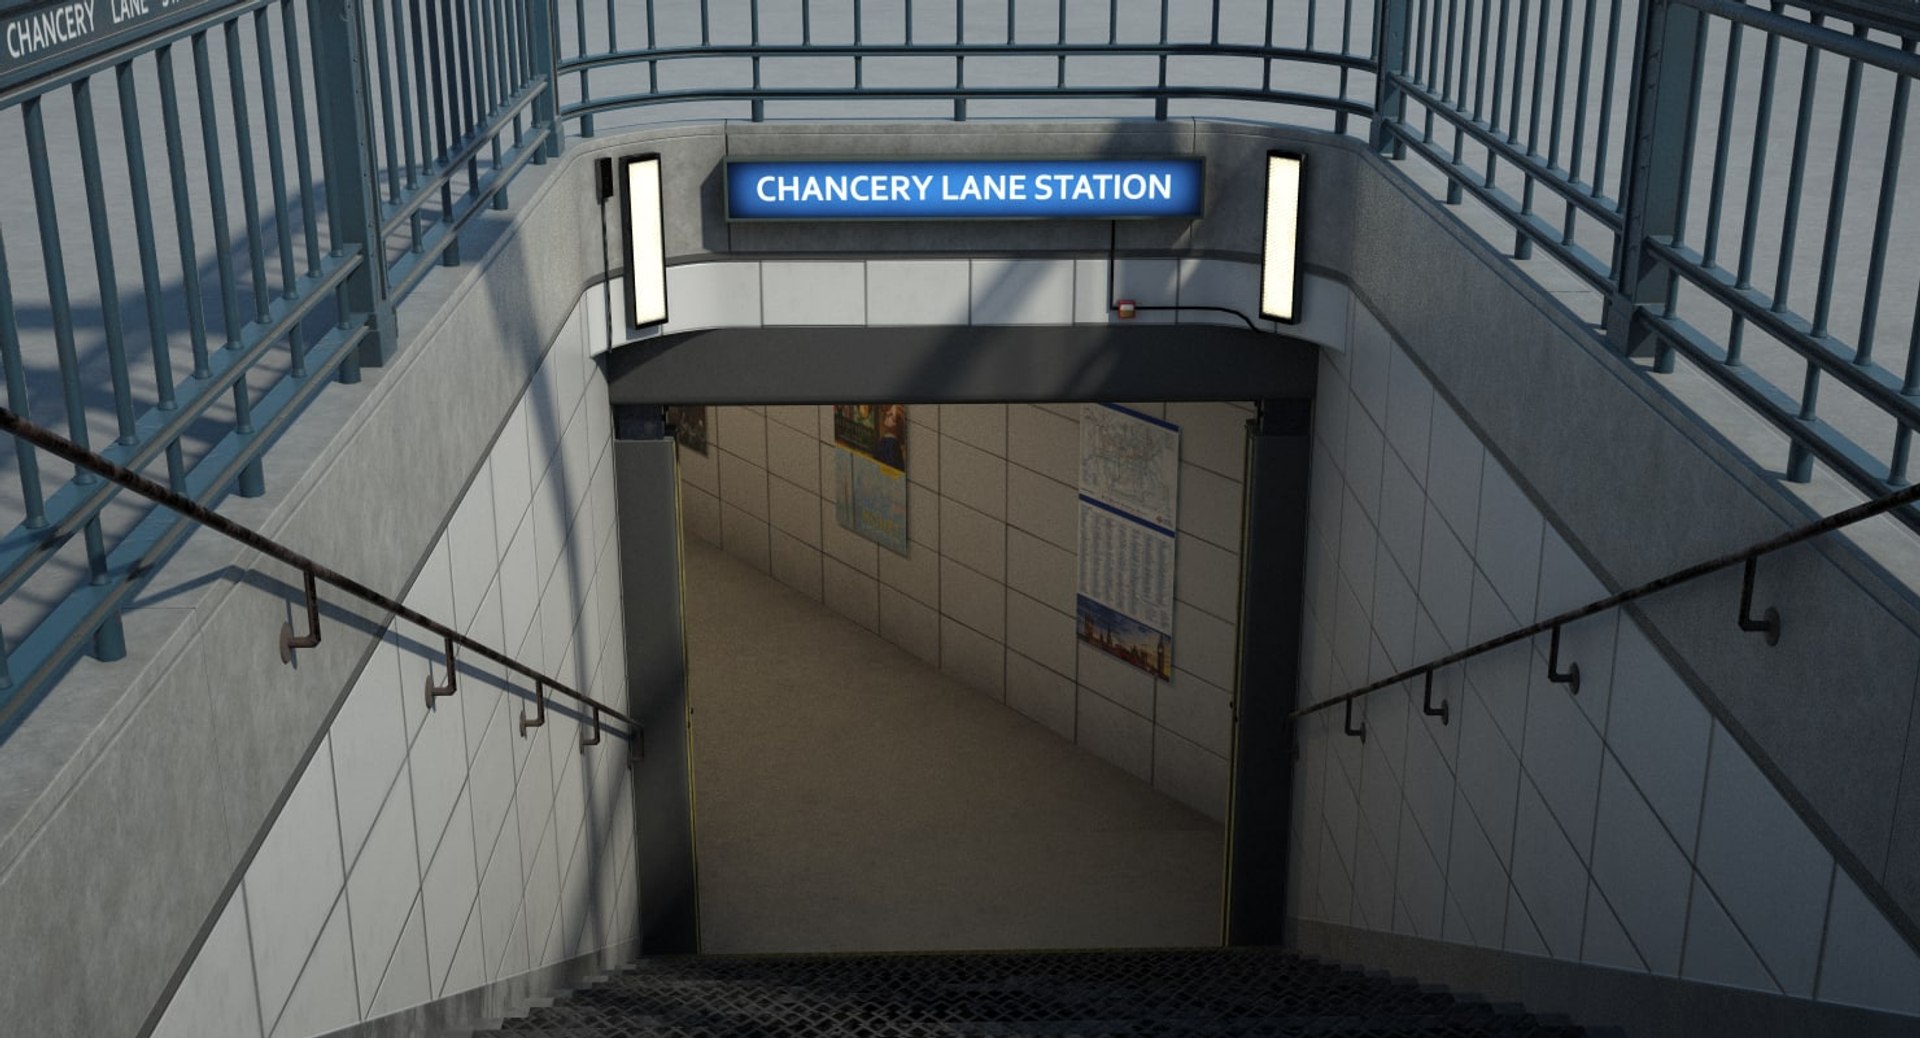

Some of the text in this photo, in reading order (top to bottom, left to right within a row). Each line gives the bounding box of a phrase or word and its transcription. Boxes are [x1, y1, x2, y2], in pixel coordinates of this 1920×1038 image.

[7, 0, 149, 58] CHANCERY LANE
[757, 173, 1171, 202] CHANCERY LANE STATION
